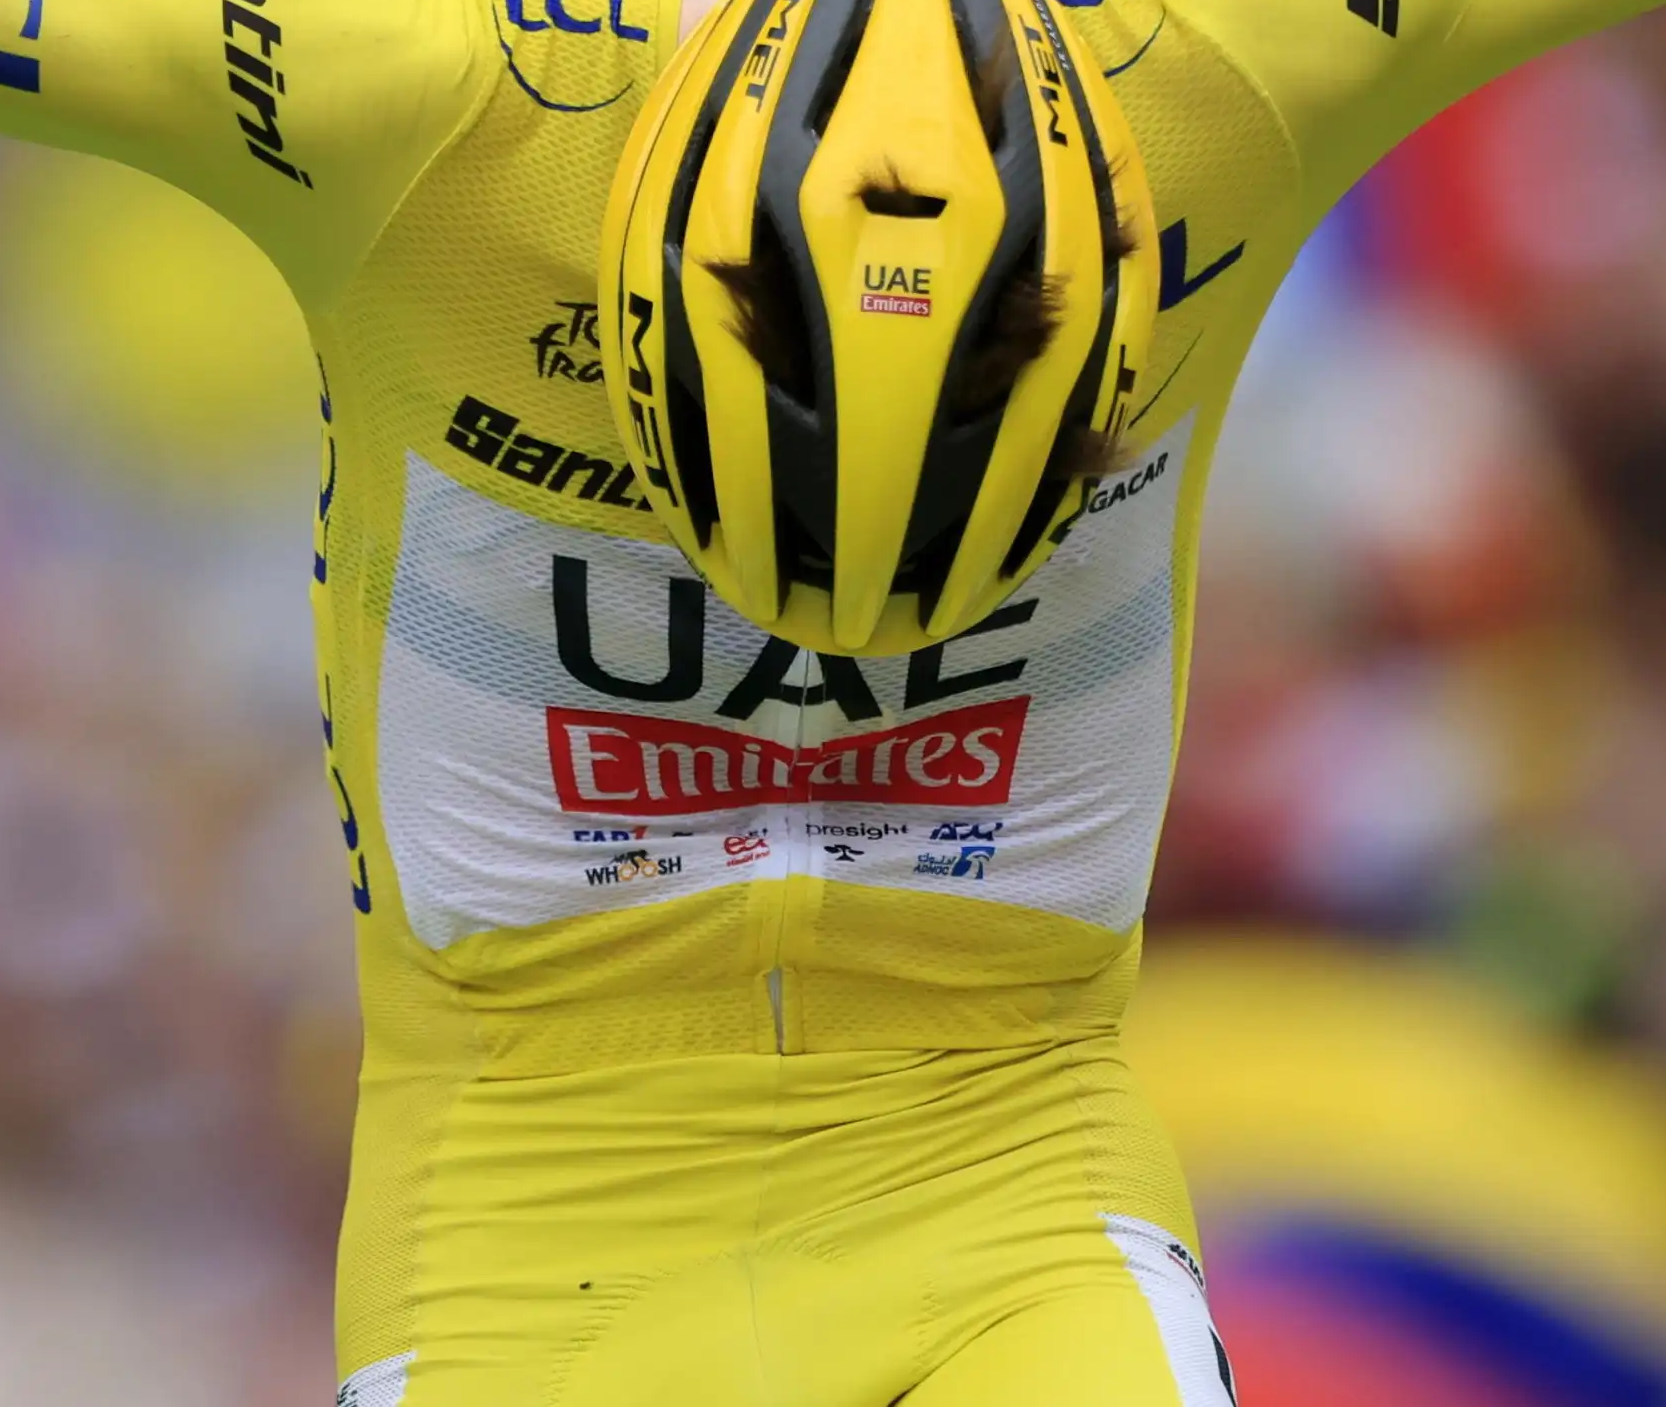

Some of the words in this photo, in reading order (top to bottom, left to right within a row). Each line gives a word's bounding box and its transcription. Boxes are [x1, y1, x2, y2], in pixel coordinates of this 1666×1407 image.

[1018, 14, 1068, 147] MET
[862, 295, 929, 315] Emirates
[864, 264, 931, 294] UAE
[628, 291, 678, 507] MET
[445, 395, 653, 512] Sant
[552, 554, 1040, 721] UAE
[563, 724, 1004, 802] Emirates
[806, 822, 910, 840] presight
